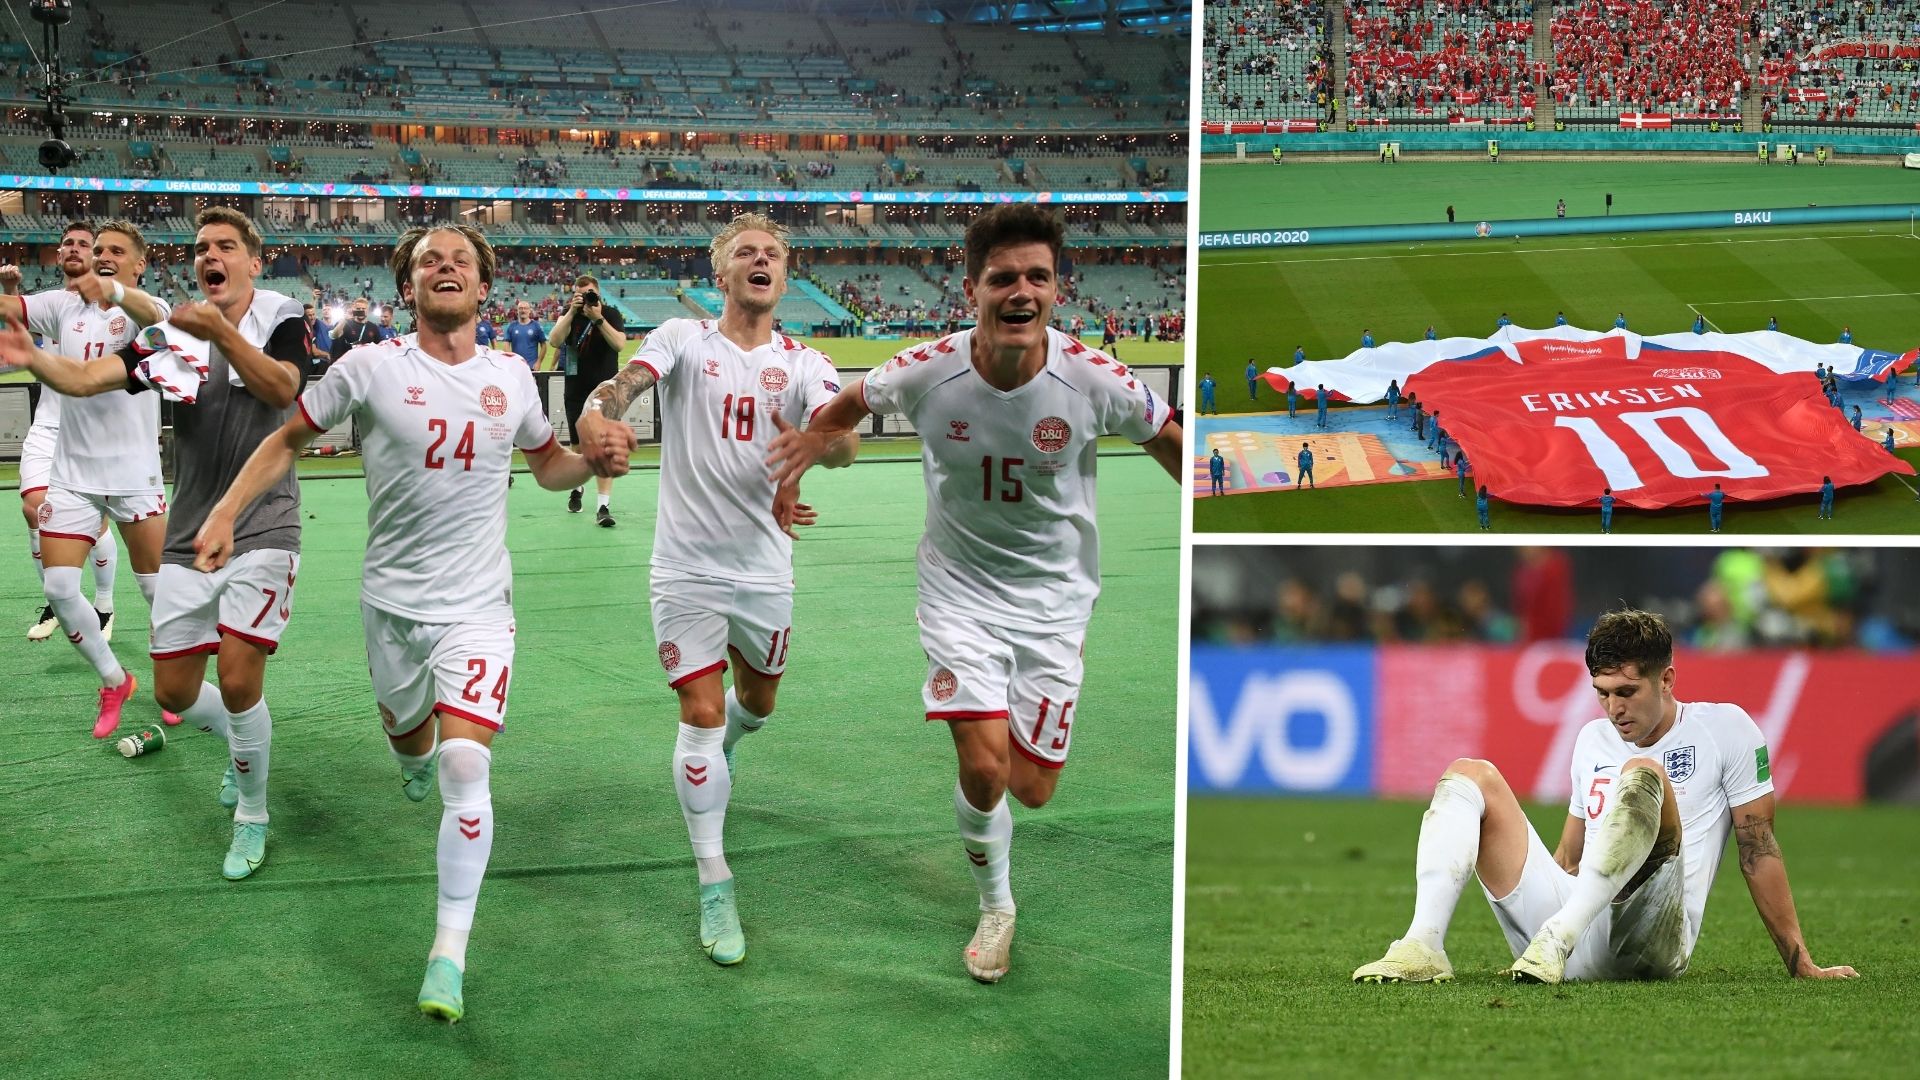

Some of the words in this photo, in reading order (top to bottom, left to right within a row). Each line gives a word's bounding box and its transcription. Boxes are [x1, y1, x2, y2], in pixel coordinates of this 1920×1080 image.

[166, 181, 190, 191] UEFA
[191, 182, 216, 192] EURO
[217, 183, 241, 192] 2020
[435, 187, 460, 196] BAKU
[642, 190, 664, 199] UEFA
[664, 190, 686, 199] EURO
[687, 191, 708, 199] 2020
[873, 192, 896, 201] BAKU
[1061, 193, 1083, 201] UEFA
[1083, 193, 1106, 201] EURO
[1106, 193, 1128, 201] 2020
[1734, 211, 1772, 224] BAKU
[1232, 231, 1272, 245] EURO
[1273, 230, 1310, 243] 2020
[84, 341, 105, 361] 17
[765, 375, 783, 384] DBU
[486, 395, 503, 406] DBU
[1521, 383, 1703, 412] ERIKSEN
[721, 393, 755, 442] 18
[1040, 428, 1063, 440] DBU
[425, 418, 476, 472] 24
[1554, 406, 1771, 492] 10
[980, 455, 1025, 503] 15
[251, 587, 277, 629] 7
[765, 626, 791, 668] 18
[462, 658, 510, 714] 24
[936, 680, 952, 692] DBU
[1030, 696, 1073, 750] 15
[1587, 778, 1611, 820] 5
